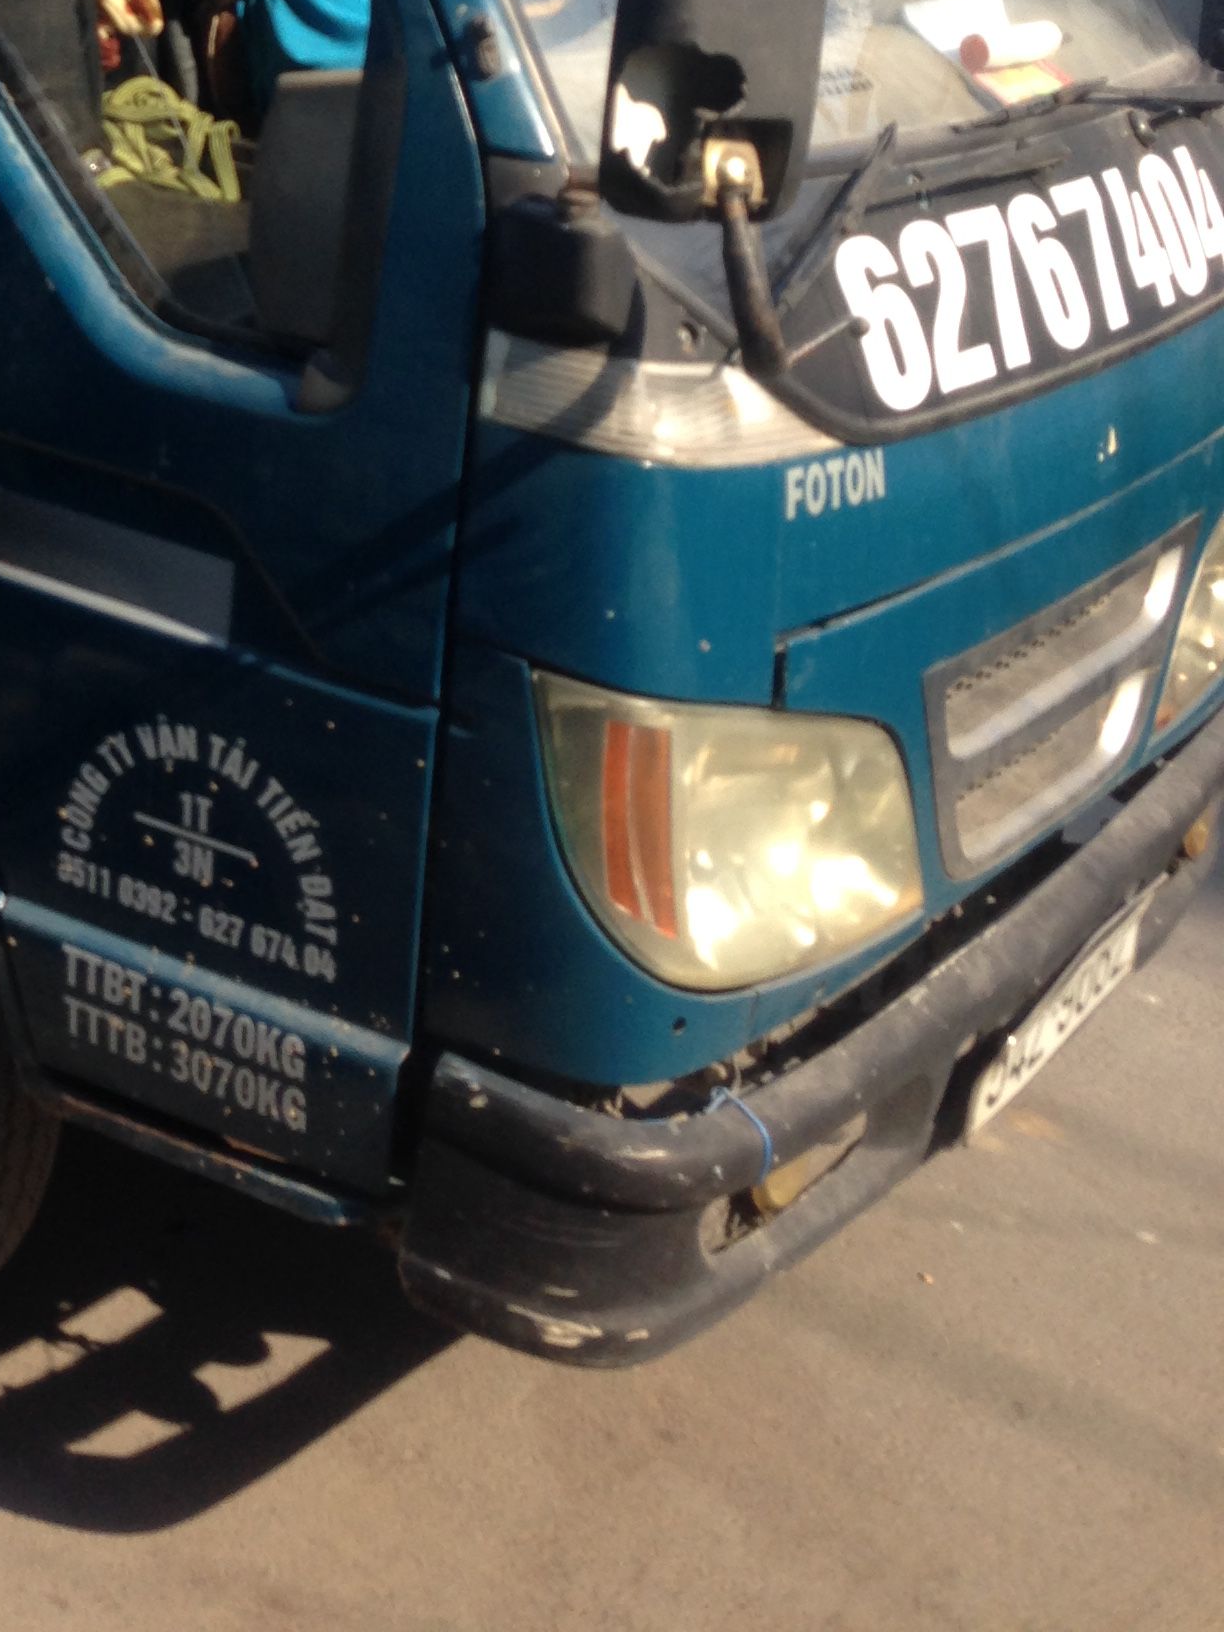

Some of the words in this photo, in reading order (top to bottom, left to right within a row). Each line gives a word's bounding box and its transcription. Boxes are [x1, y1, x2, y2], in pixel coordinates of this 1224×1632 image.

[784, 446, 886, 522] FOTON
[96, 732, 135, 776] TY
[134, 713, 199, 773] VẬN
[209, 733, 260, 790] TẢI
[179, 791, 213, 834] 1T
[167, 987, 306, 1082] 2070KG
[169, 1039, 307, 1134] 3070KG
